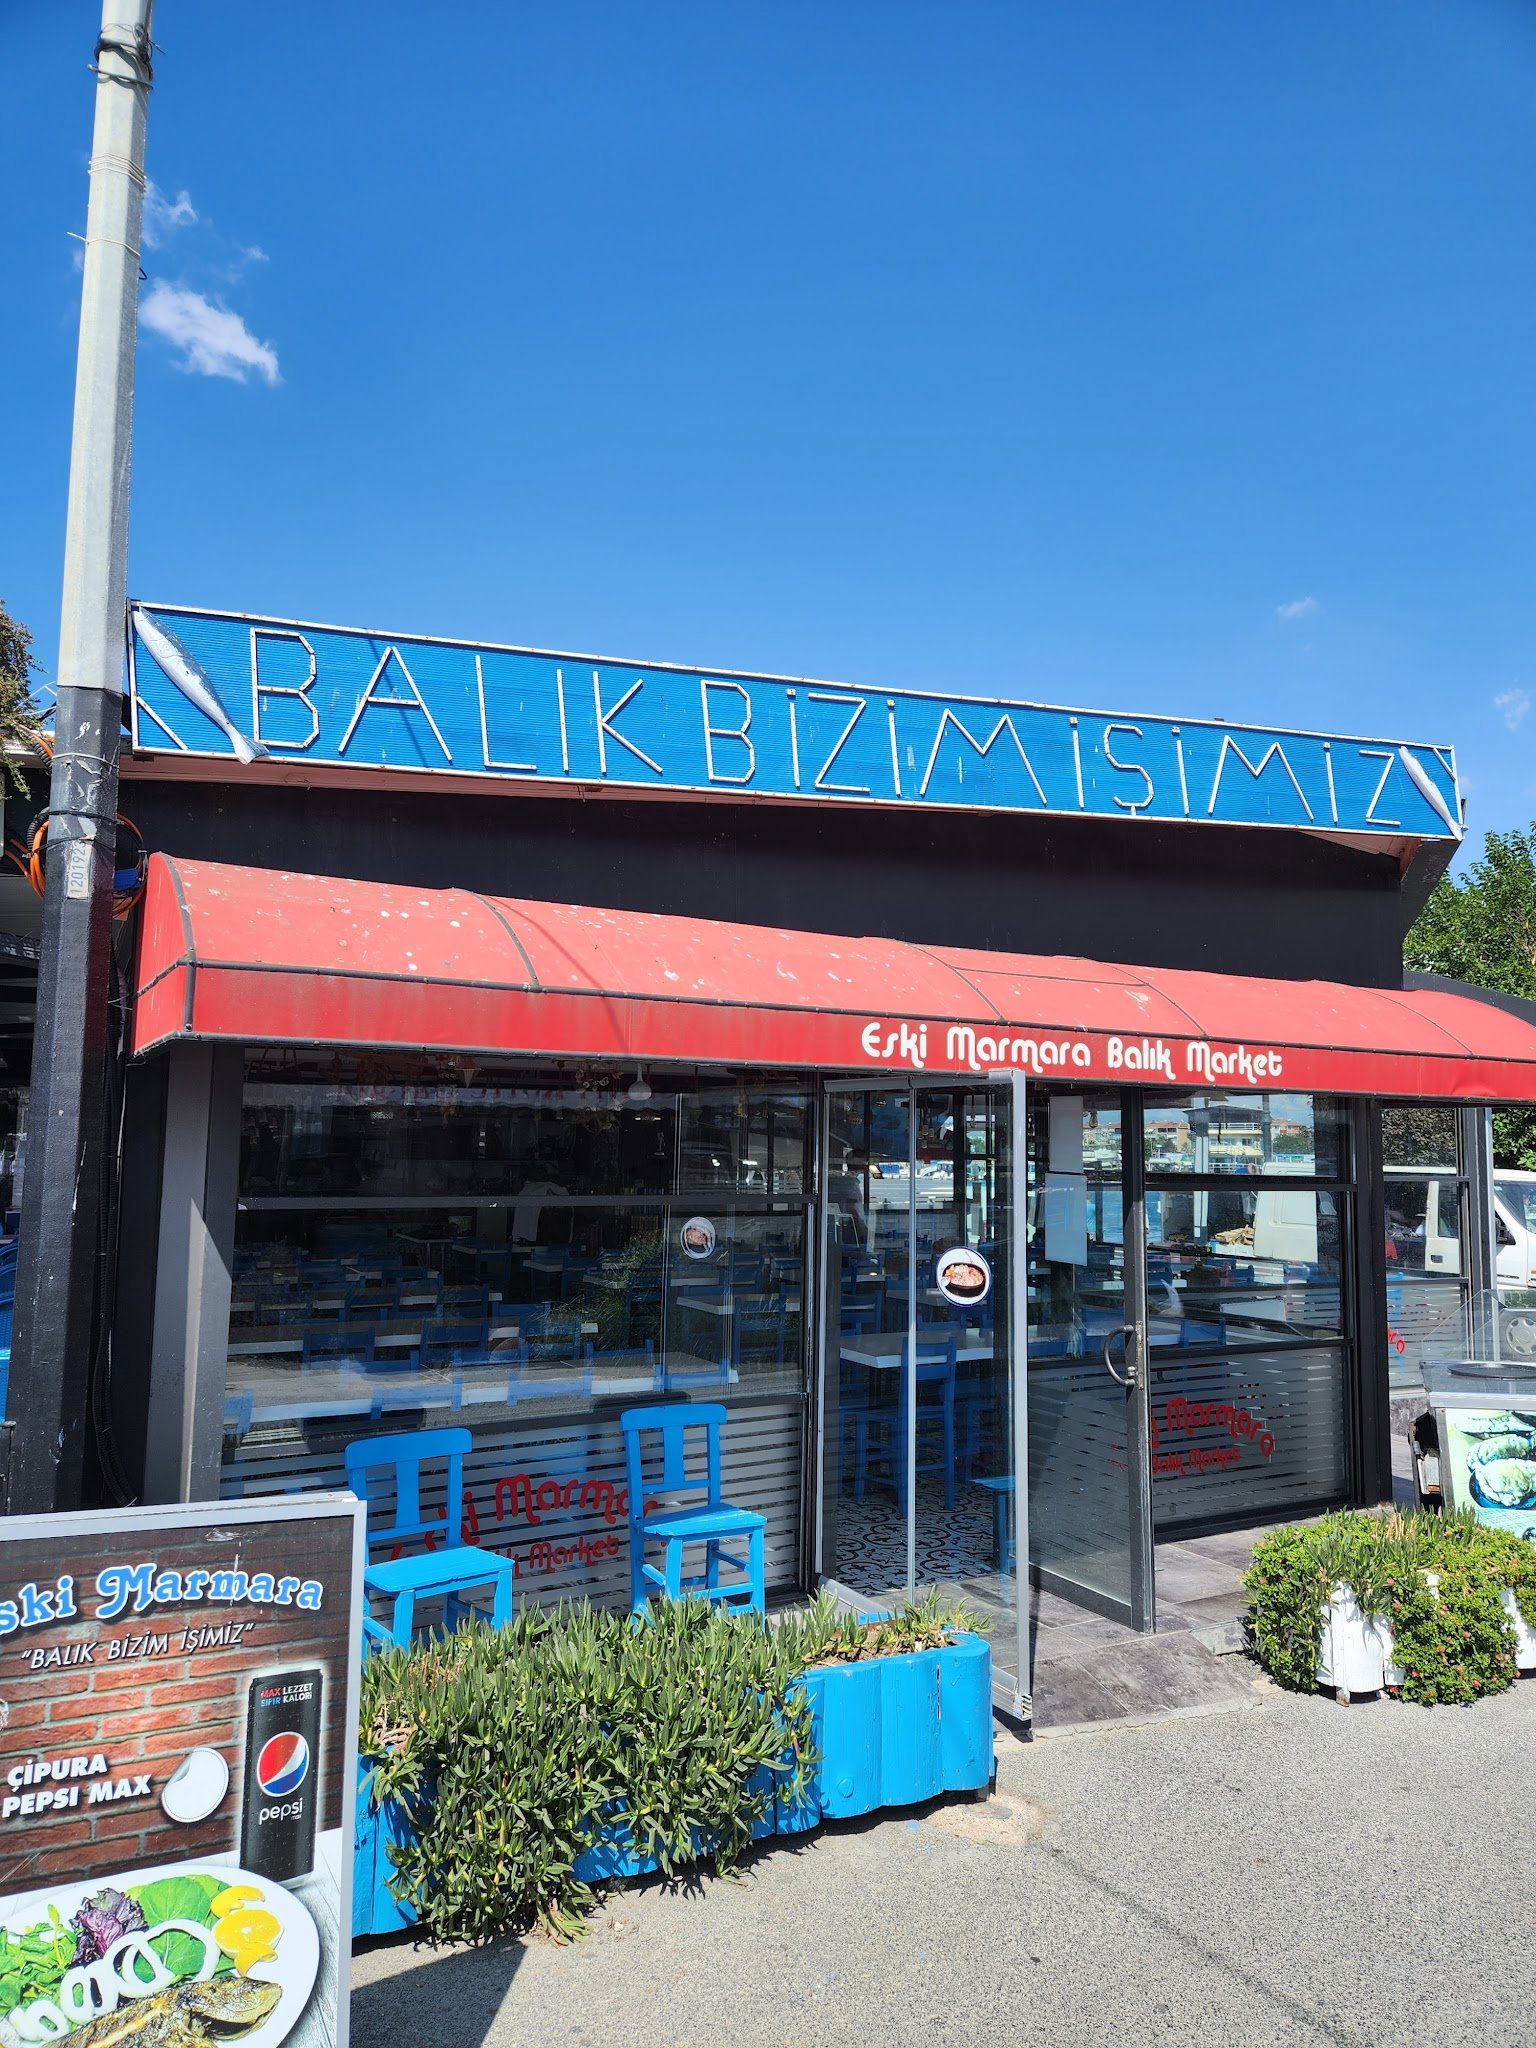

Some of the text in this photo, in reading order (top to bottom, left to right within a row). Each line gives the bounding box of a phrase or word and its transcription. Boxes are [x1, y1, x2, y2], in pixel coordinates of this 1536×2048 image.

[249, 626, 663, 775] BALIK
[700, 679, 1048, 806] BİZİM
[861, 1021, 928, 1069] Eski
[946, 1025, 1092, 1074] Marmara
[1186, 1041, 1283, 1084] Market
[1166, 1397, 1275, 1458] Marmara
[529, 1534, 620, 1573] Market
[0, 1562, 325, 1636] ski Marmara
[107, 1631, 169, 1661] BİZİM
[260, 1682, 314, 1699] MAX LEZZET
[7, 1753, 108, 1793] ÇİPURA
[1, 1773, 153, 1819] PEPSI MAX
[258, 1797, 304, 1826] pepsi
